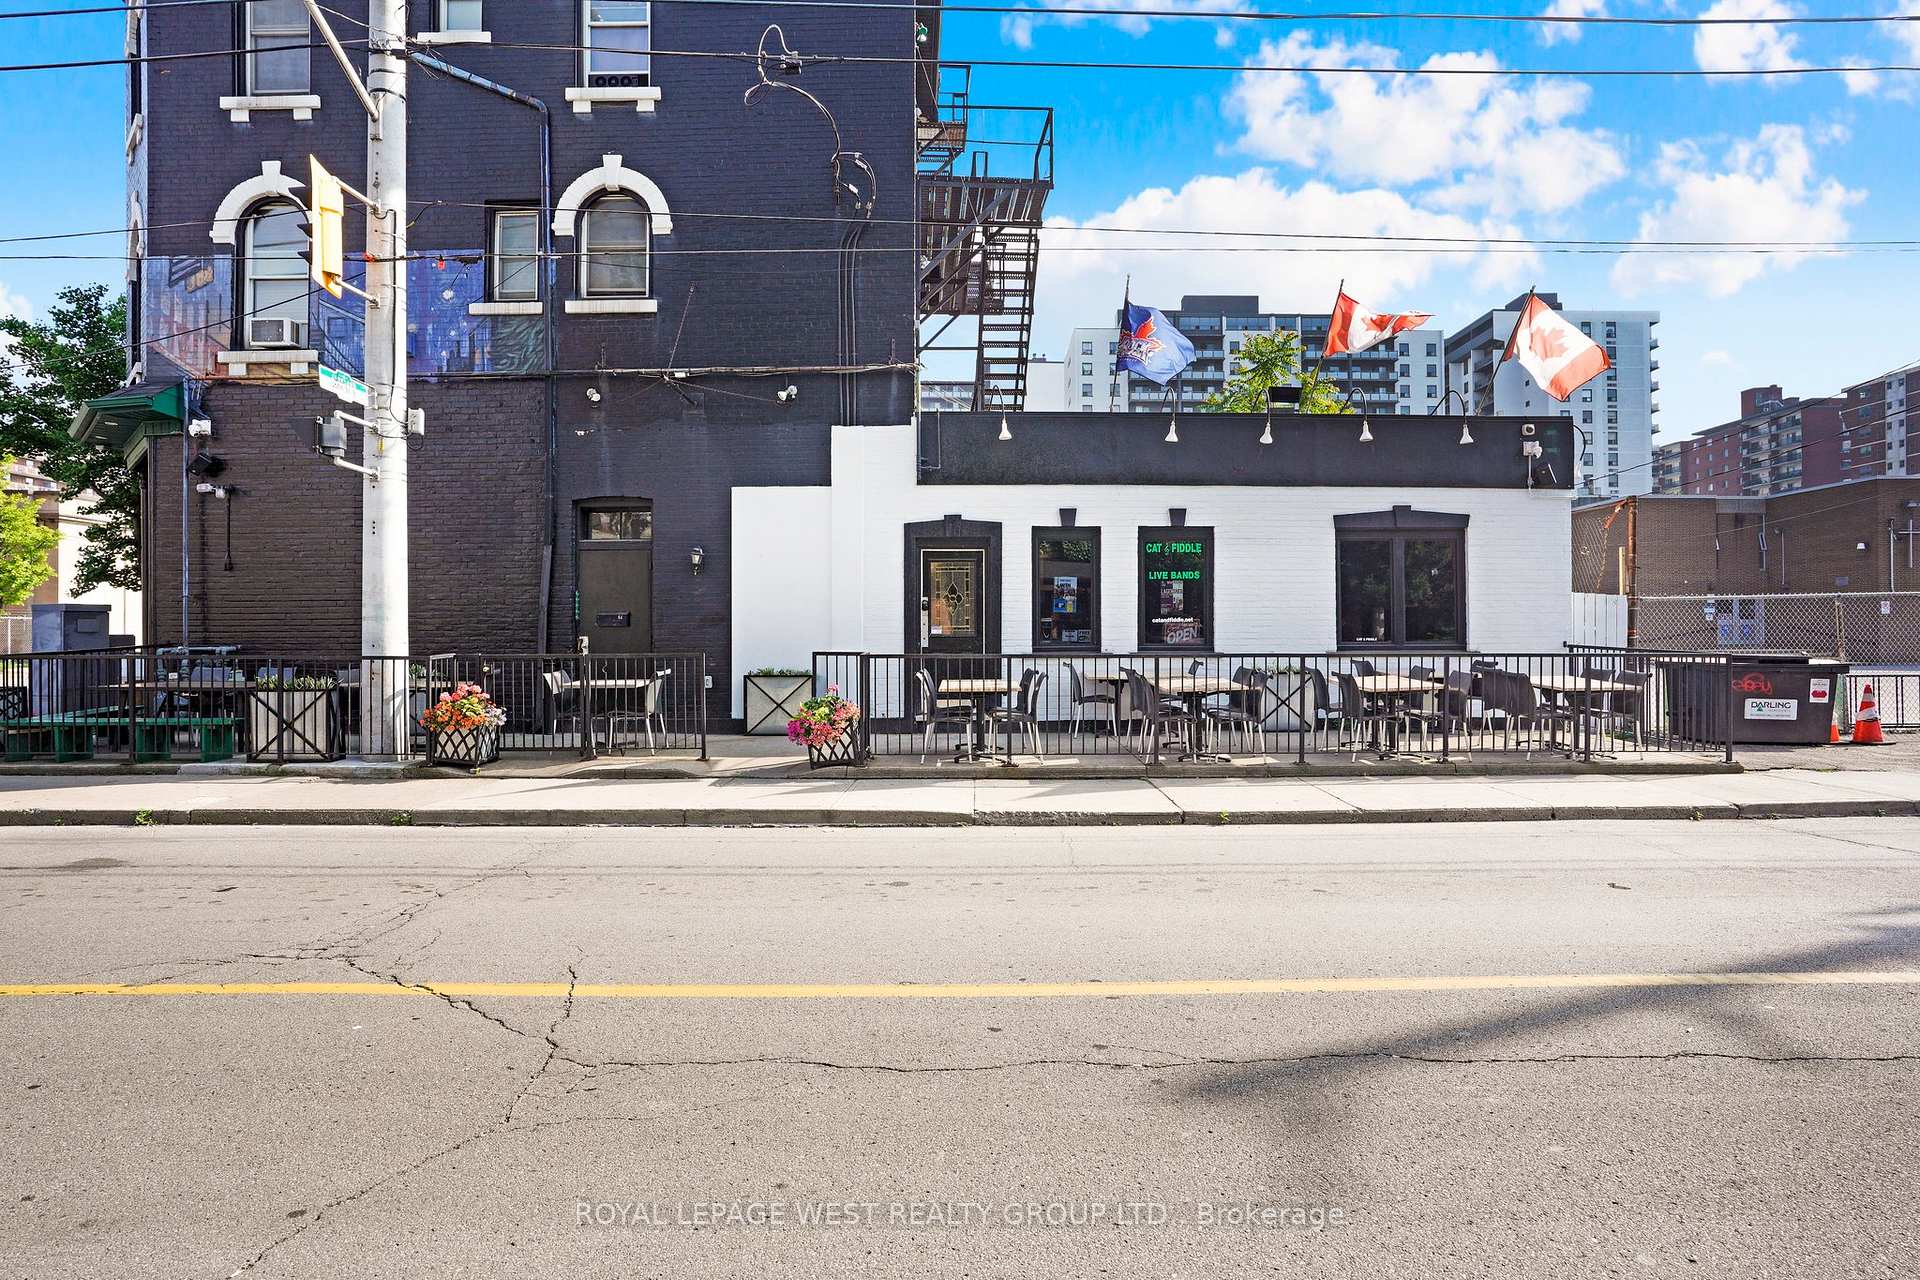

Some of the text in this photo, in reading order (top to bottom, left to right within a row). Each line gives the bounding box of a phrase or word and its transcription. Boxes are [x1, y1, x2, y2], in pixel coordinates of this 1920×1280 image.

[1146, 543, 1202, 553] CAT FIDDLE
[1149, 571, 1200, 580] LIVE BANDS
[1166, 626, 1198, 644] OPEN
[1751, 701, 1792, 709] DARLING
